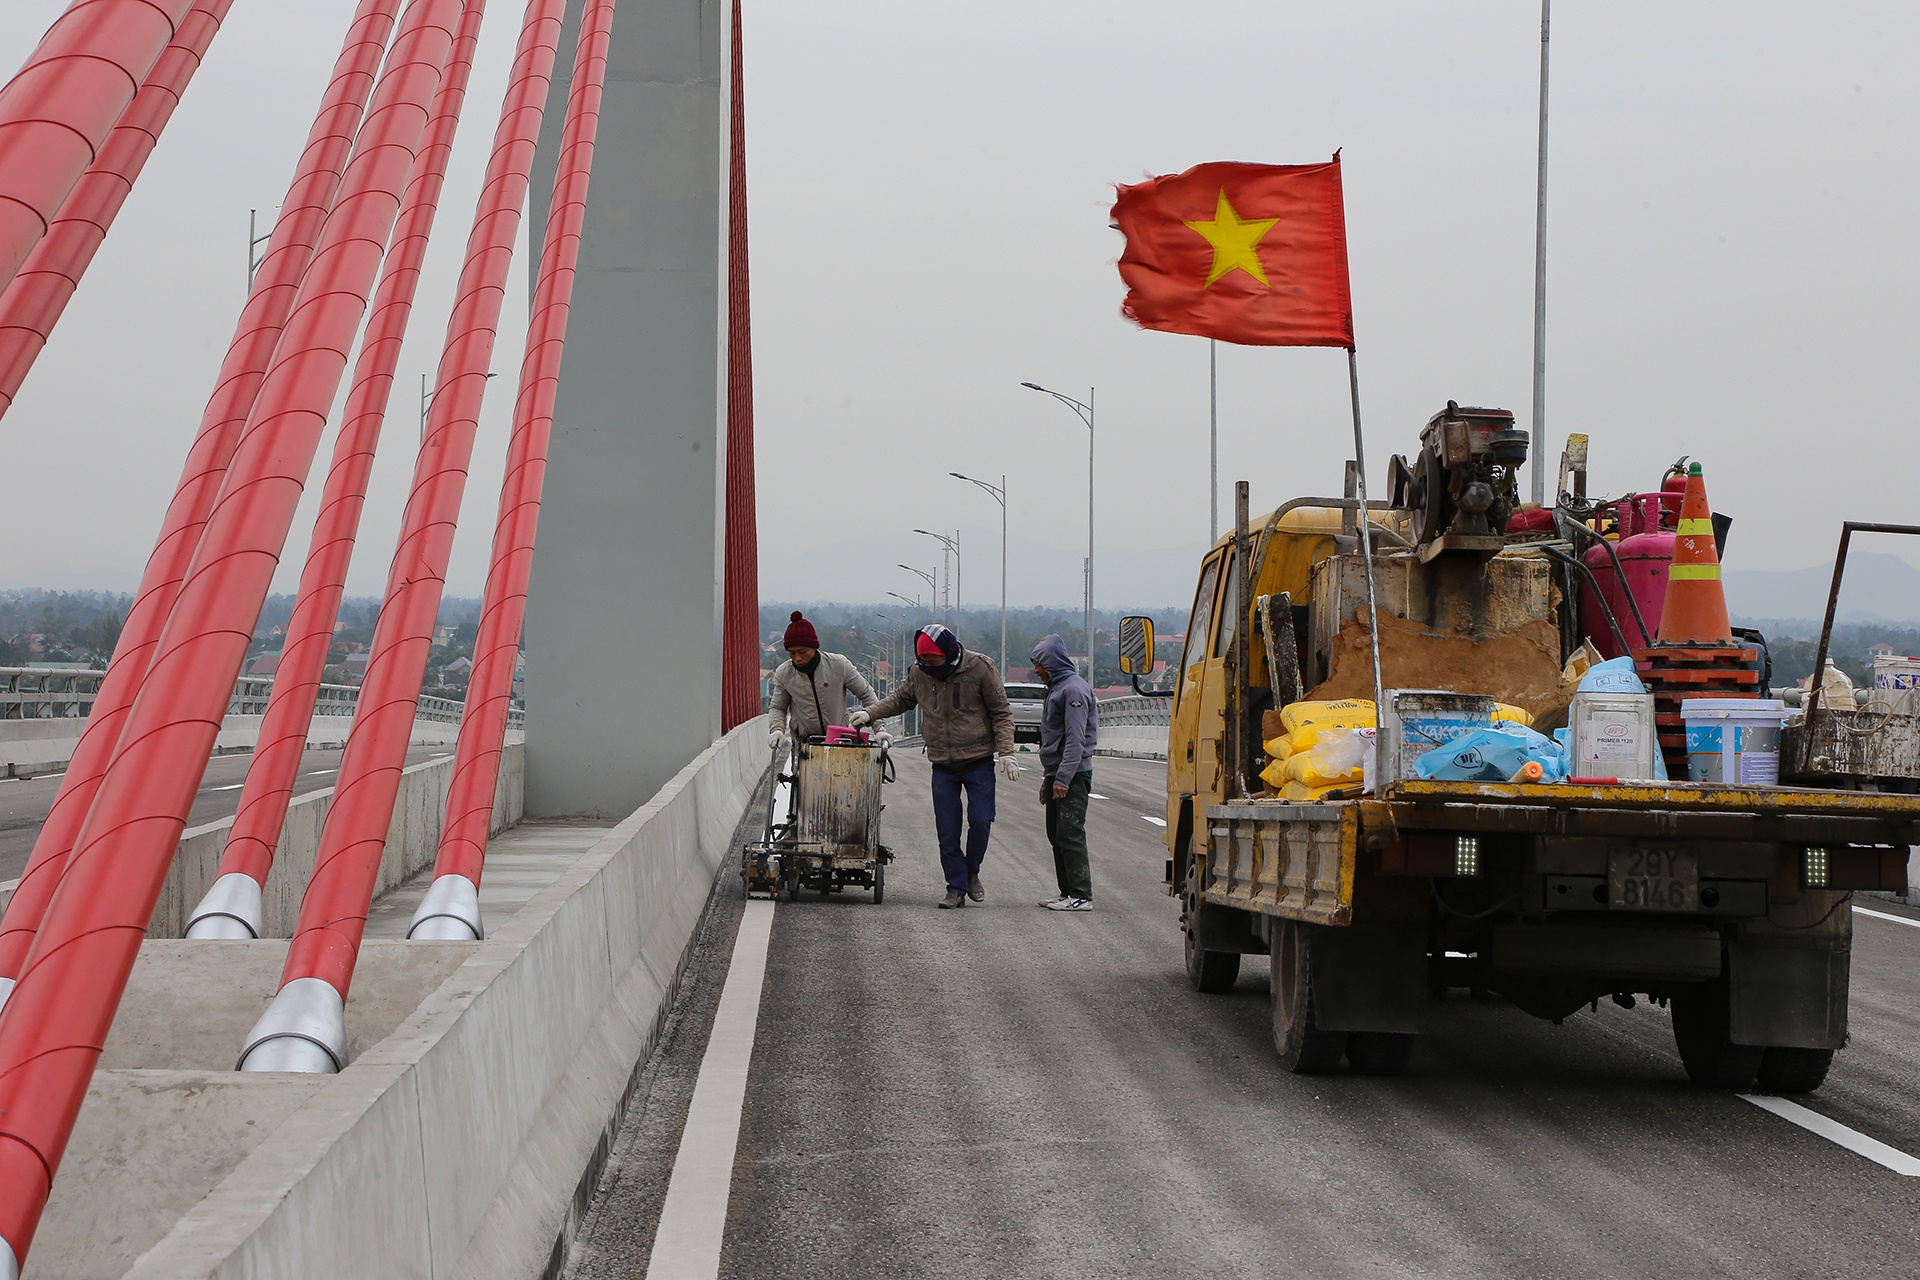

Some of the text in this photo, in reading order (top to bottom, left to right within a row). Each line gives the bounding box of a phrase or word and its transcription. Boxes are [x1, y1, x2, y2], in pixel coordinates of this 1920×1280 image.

[1328, 702, 1358, 710] YELLOW
[1628, 848, 1679, 877] 29Y
[1623, 877, 1685, 907] 8146
